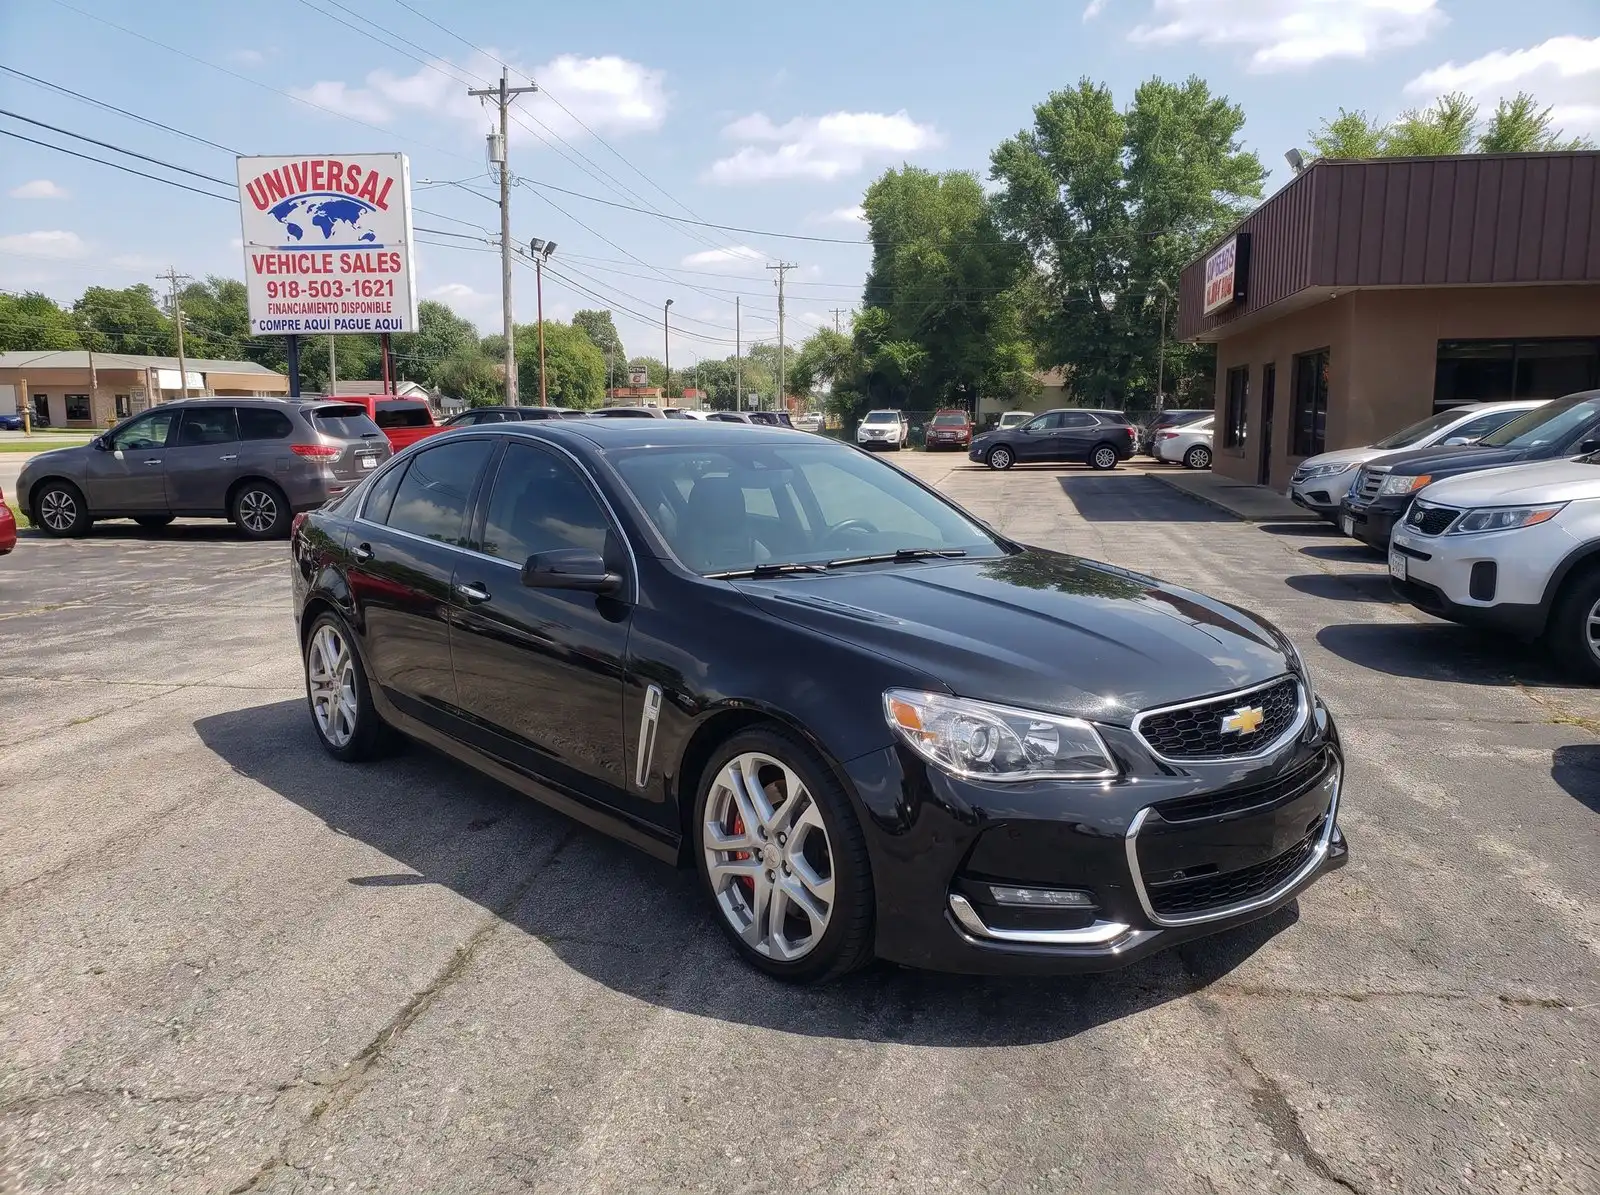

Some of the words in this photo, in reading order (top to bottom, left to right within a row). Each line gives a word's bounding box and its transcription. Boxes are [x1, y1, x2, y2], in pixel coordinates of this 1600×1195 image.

[246, 160, 394, 210] UNIVERSAL
[252, 254, 333, 274] VEHICLE
[340, 252, 401, 273] SALES
[267, 280, 394, 299] 918-503-1621
[268, 302, 338, 314] FINANCIAMIENTO
[342, 302, 392, 314] DISPONIBLE
[260, 319, 301, 331] COMPRE
[335, 318, 371, 330] PAGUE
